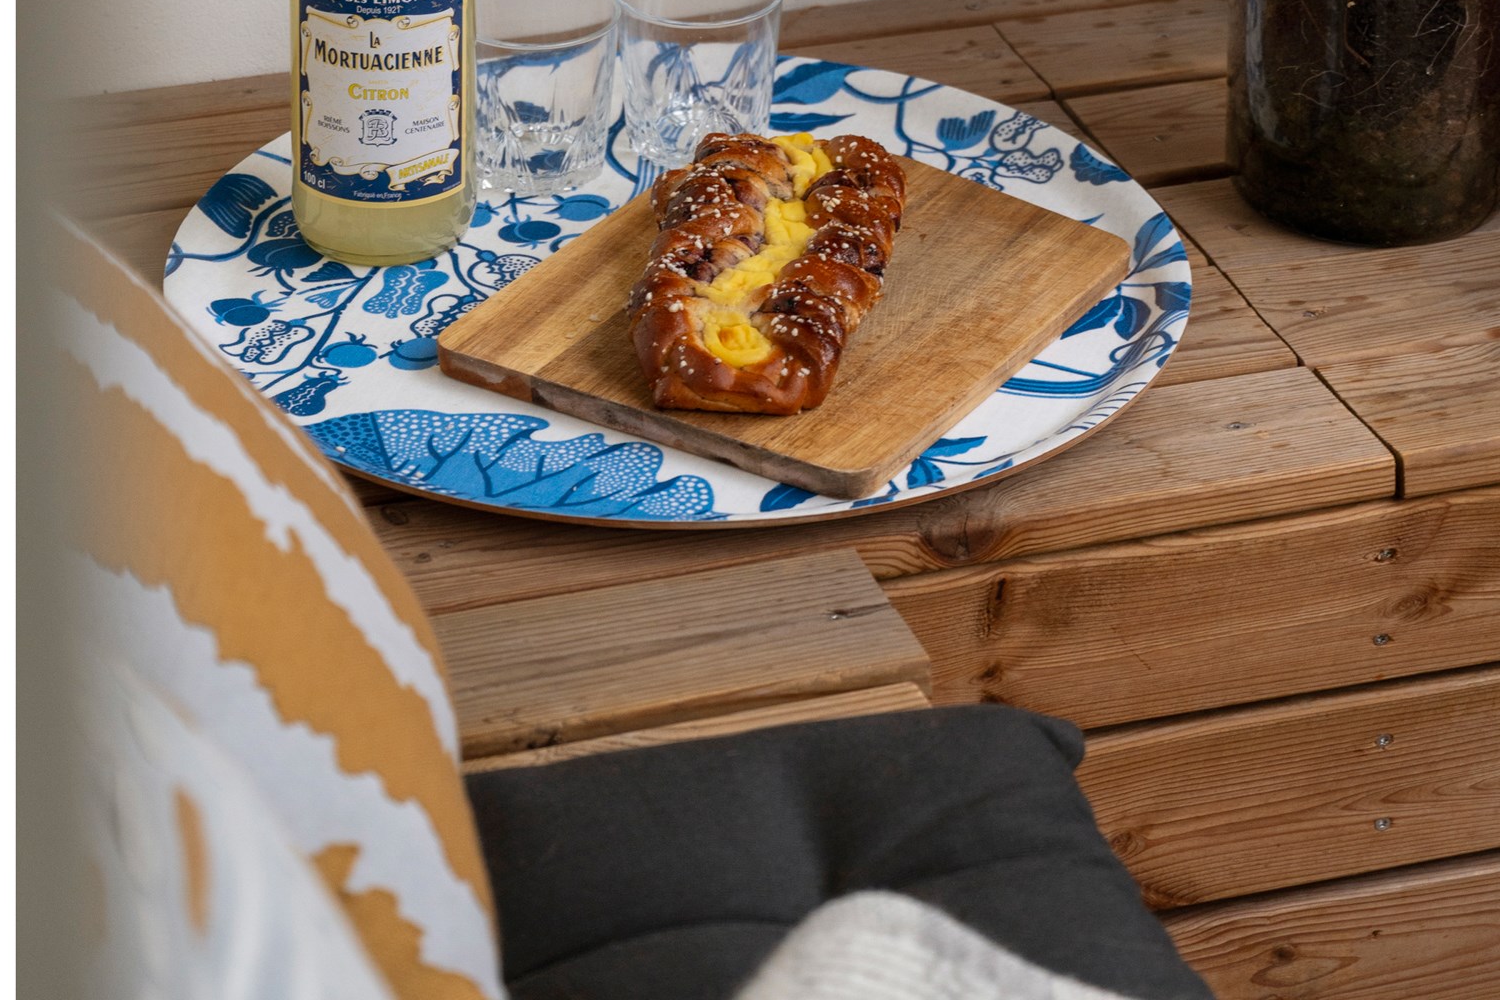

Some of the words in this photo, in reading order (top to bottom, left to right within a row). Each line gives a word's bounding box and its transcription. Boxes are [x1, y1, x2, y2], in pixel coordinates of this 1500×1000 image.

[356, 5, 381, 15] Depuis
[314, 38, 444, 71] MORTUACIENNE
[318, 120, 351, 134] BOISSONS
[404, 121, 445, 135] CENTENAIRE
[411, 115, 440, 127] MAISON
[398, 153, 450, 180] ARTISANALE
[303, 170, 317, 185] 100
[317, 179, 326, 189] cl
